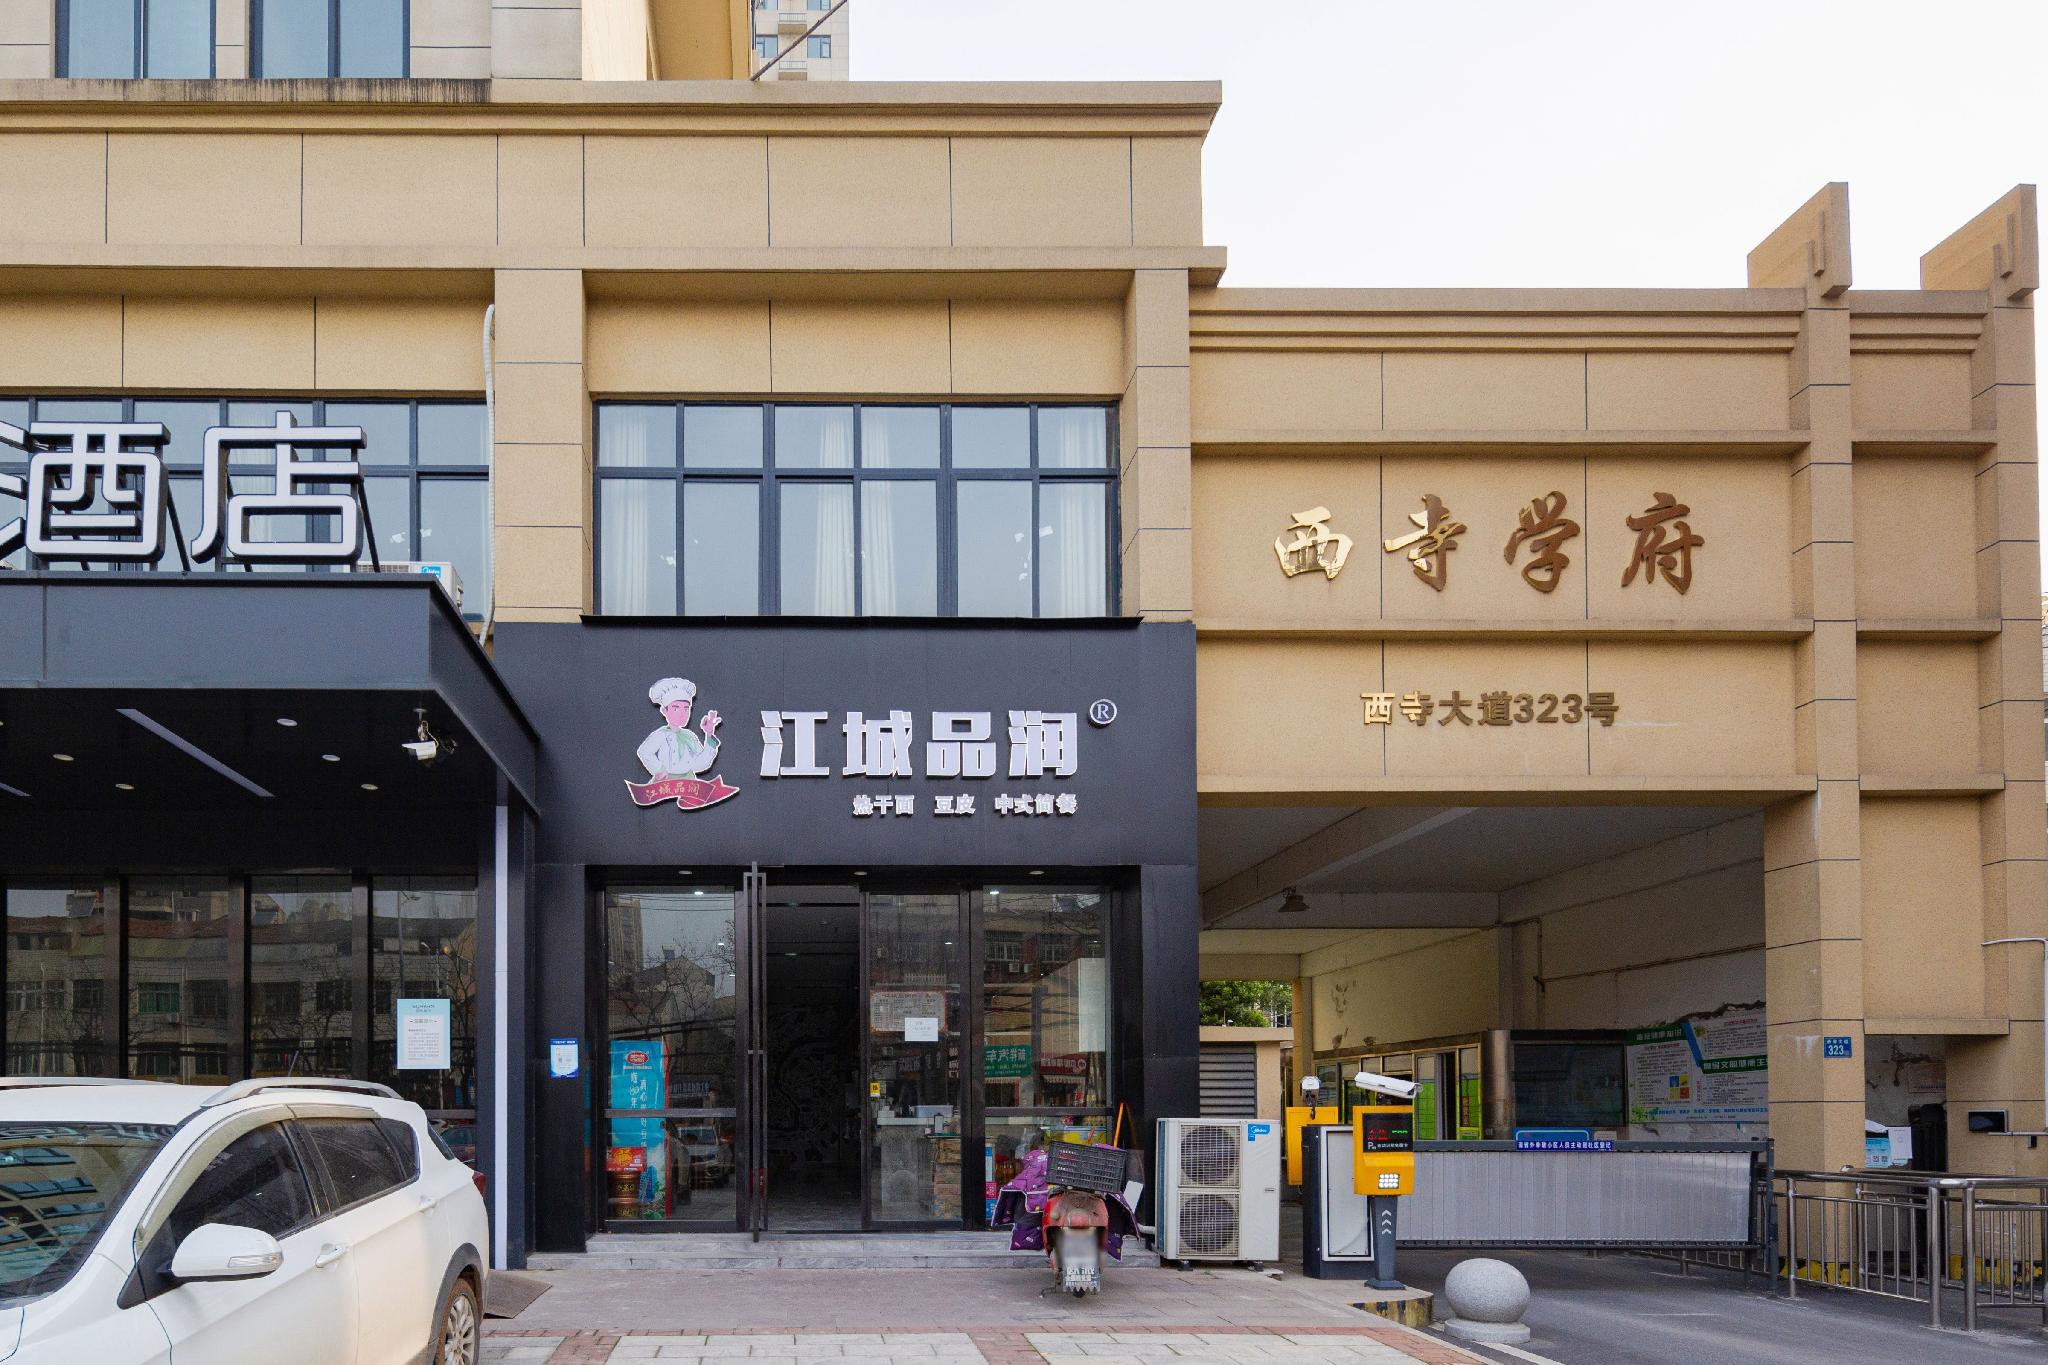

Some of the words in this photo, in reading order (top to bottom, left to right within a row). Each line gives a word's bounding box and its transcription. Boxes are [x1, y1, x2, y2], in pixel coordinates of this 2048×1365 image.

[0, 410, 366, 562] 酒店
[1274, 490, 1706, 595] 西寺学府
[1360, 690, 1620, 727] 西寺大道323号
[760, 709, 1078, 778] 江城品润
[853, 794, 915, 816] 热干面
[934, 793, 976, 816] 豆皮
[994, 793, 1079, 816] 中式简餐
[1828, 1045, 1844, 1055] 323
